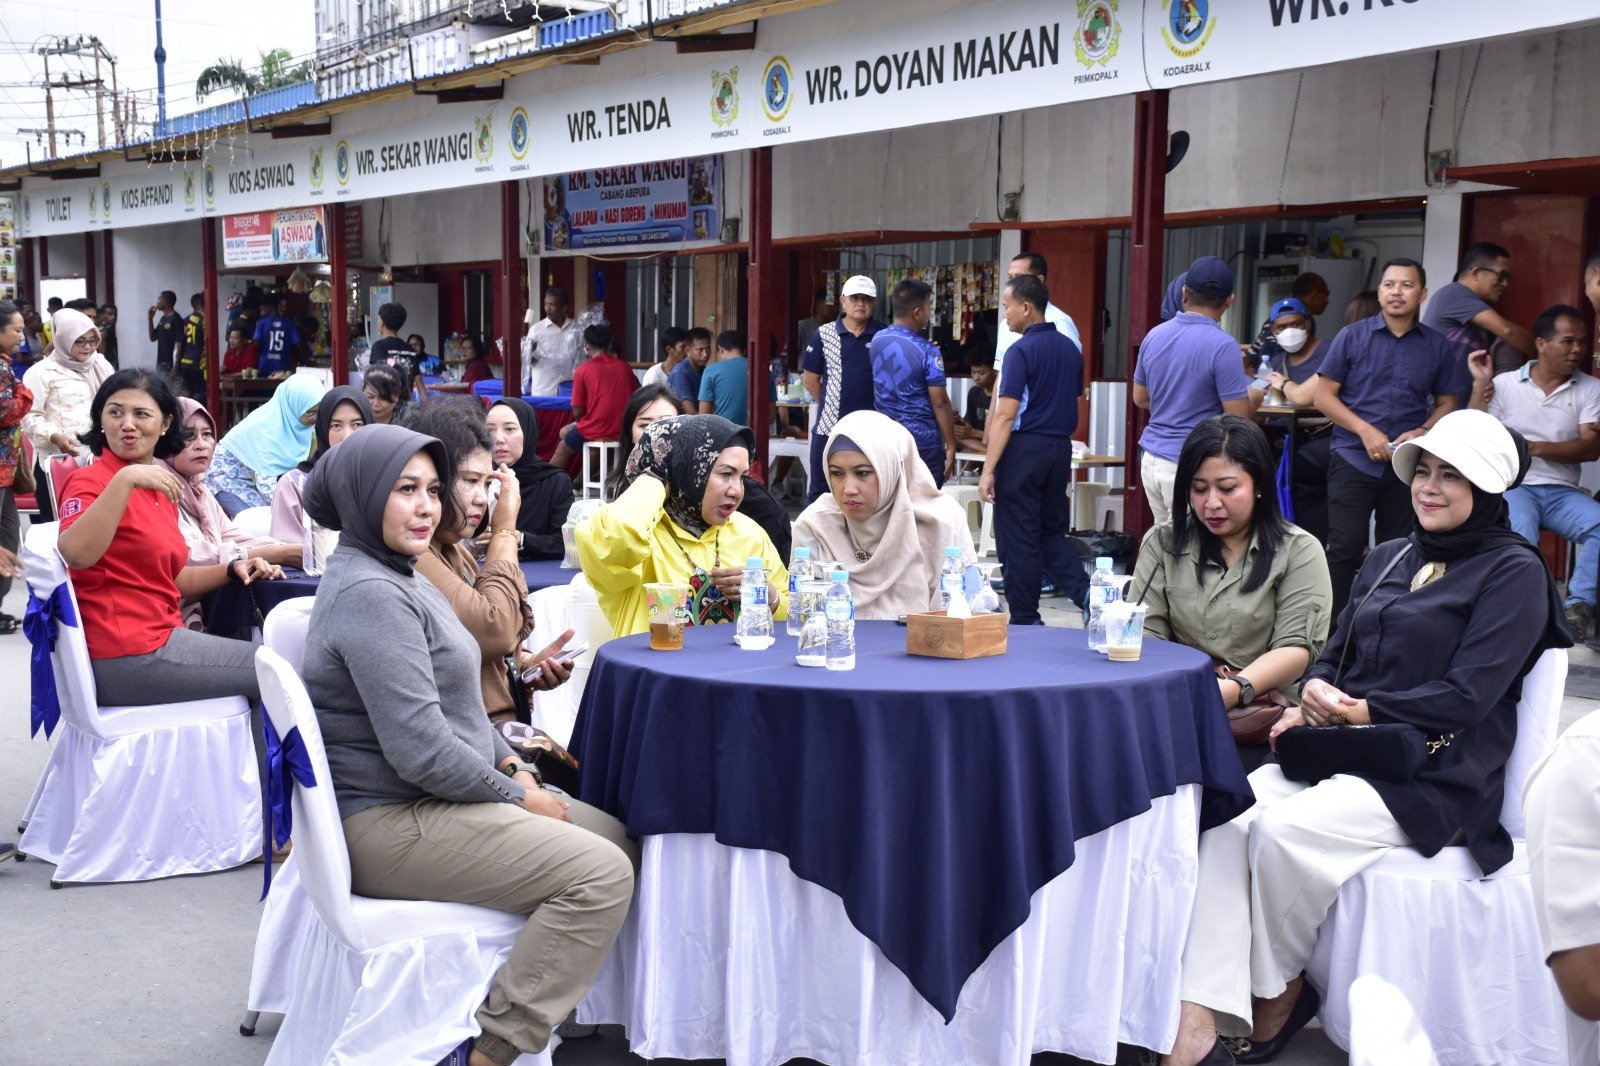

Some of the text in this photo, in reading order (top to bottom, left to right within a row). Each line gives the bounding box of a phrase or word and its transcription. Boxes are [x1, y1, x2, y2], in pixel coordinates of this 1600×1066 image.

[806, 65, 848, 105] WR.
[855, 45, 945, 97] DOYAN
[953, 23, 1060, 81] MAKAN
[1163, 61, 1211, 77] KODAERAL X
[1073, 70, 1119, 85] PRIMKOPAL X
[567, 97, 671, 143] WR. TENDA
[356, 132, 473, 176] WR. SEKAR WANGI
[229, 163, 295, 195] KIOS ASWAIQ
[594, 164, 638, 188] SEKAR
[642, 159, 686, 180] WANGI
[121, 184, 173, 209] KIOS AFFANDI
[600, 186, 651, 201] CABANG ABEPURA
[45, 196, 71, 222] TOILET
[572, 201, 688, 228] LALAPAN NASI GORENG MINUMAN
[281, 224, 313, 243] ASWAIQ
[269, 330, 285, 351] 15
